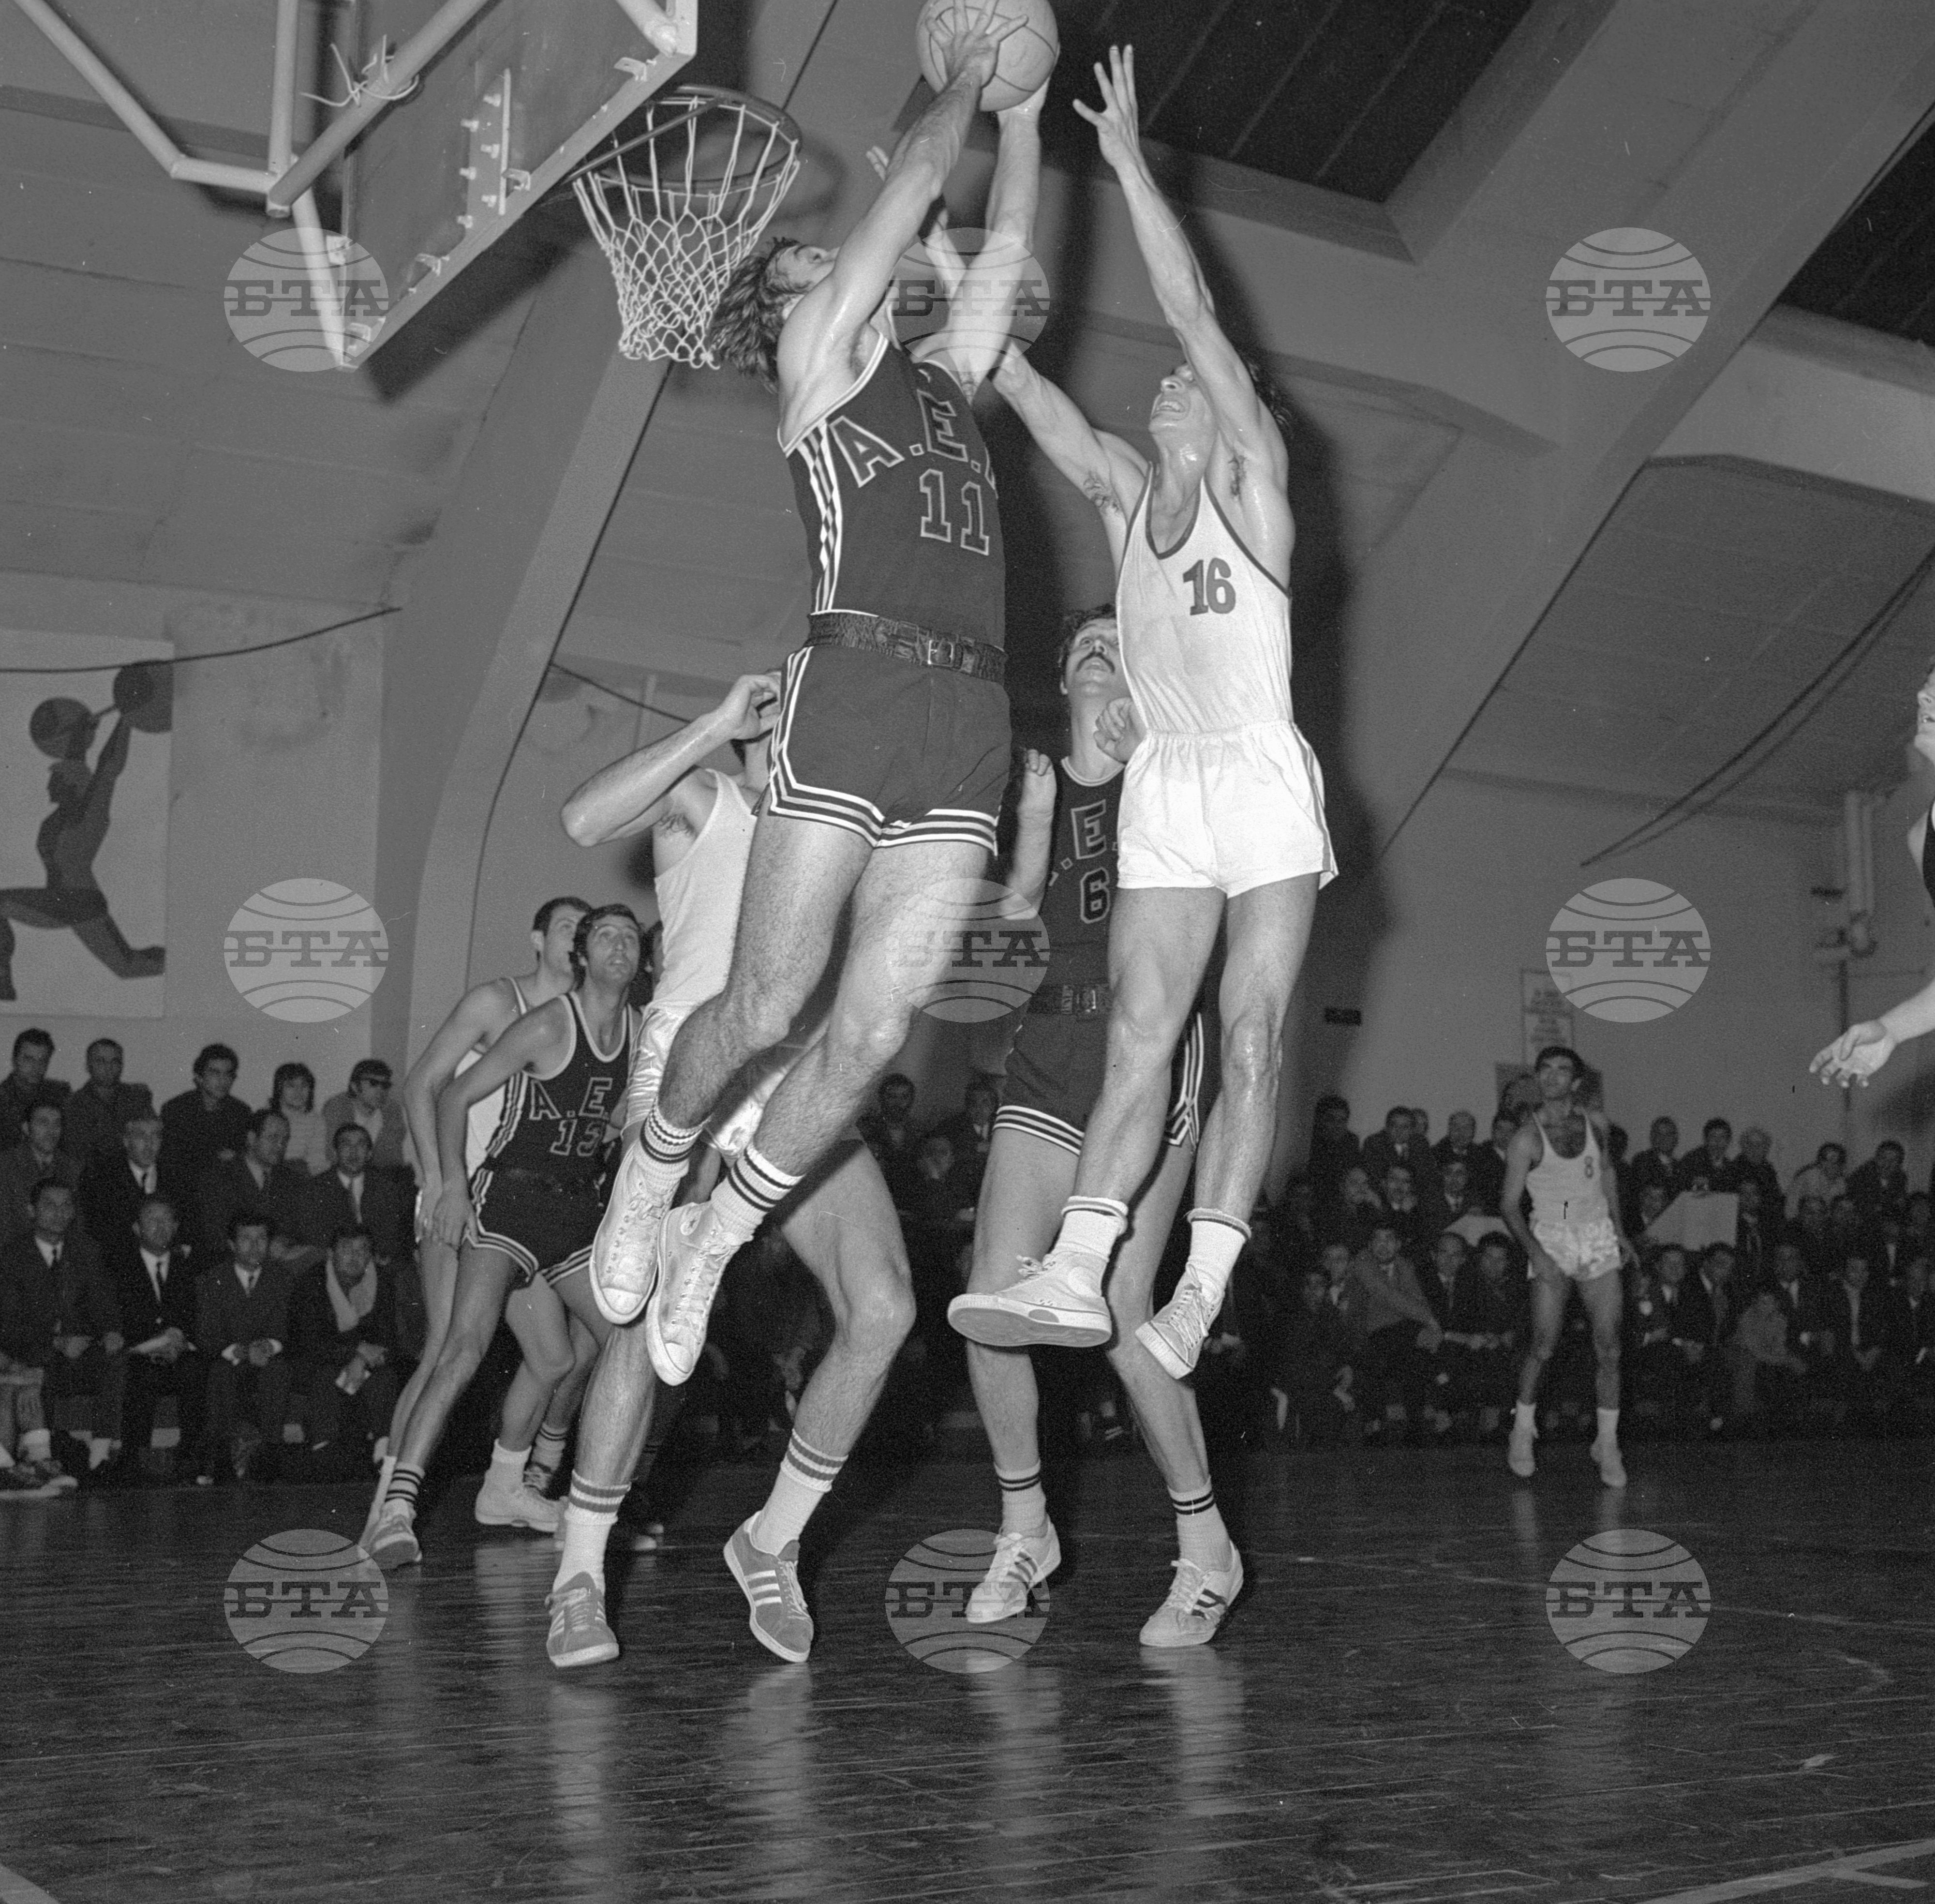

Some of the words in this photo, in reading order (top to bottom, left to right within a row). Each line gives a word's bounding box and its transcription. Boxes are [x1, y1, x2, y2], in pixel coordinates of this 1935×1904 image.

[919, 468, 989, 556] 11
[1182, 557, 1236, 616] 16
[1080, 867, 1110, 925] 6
[1583, 1155, 1594, 1179] 8
